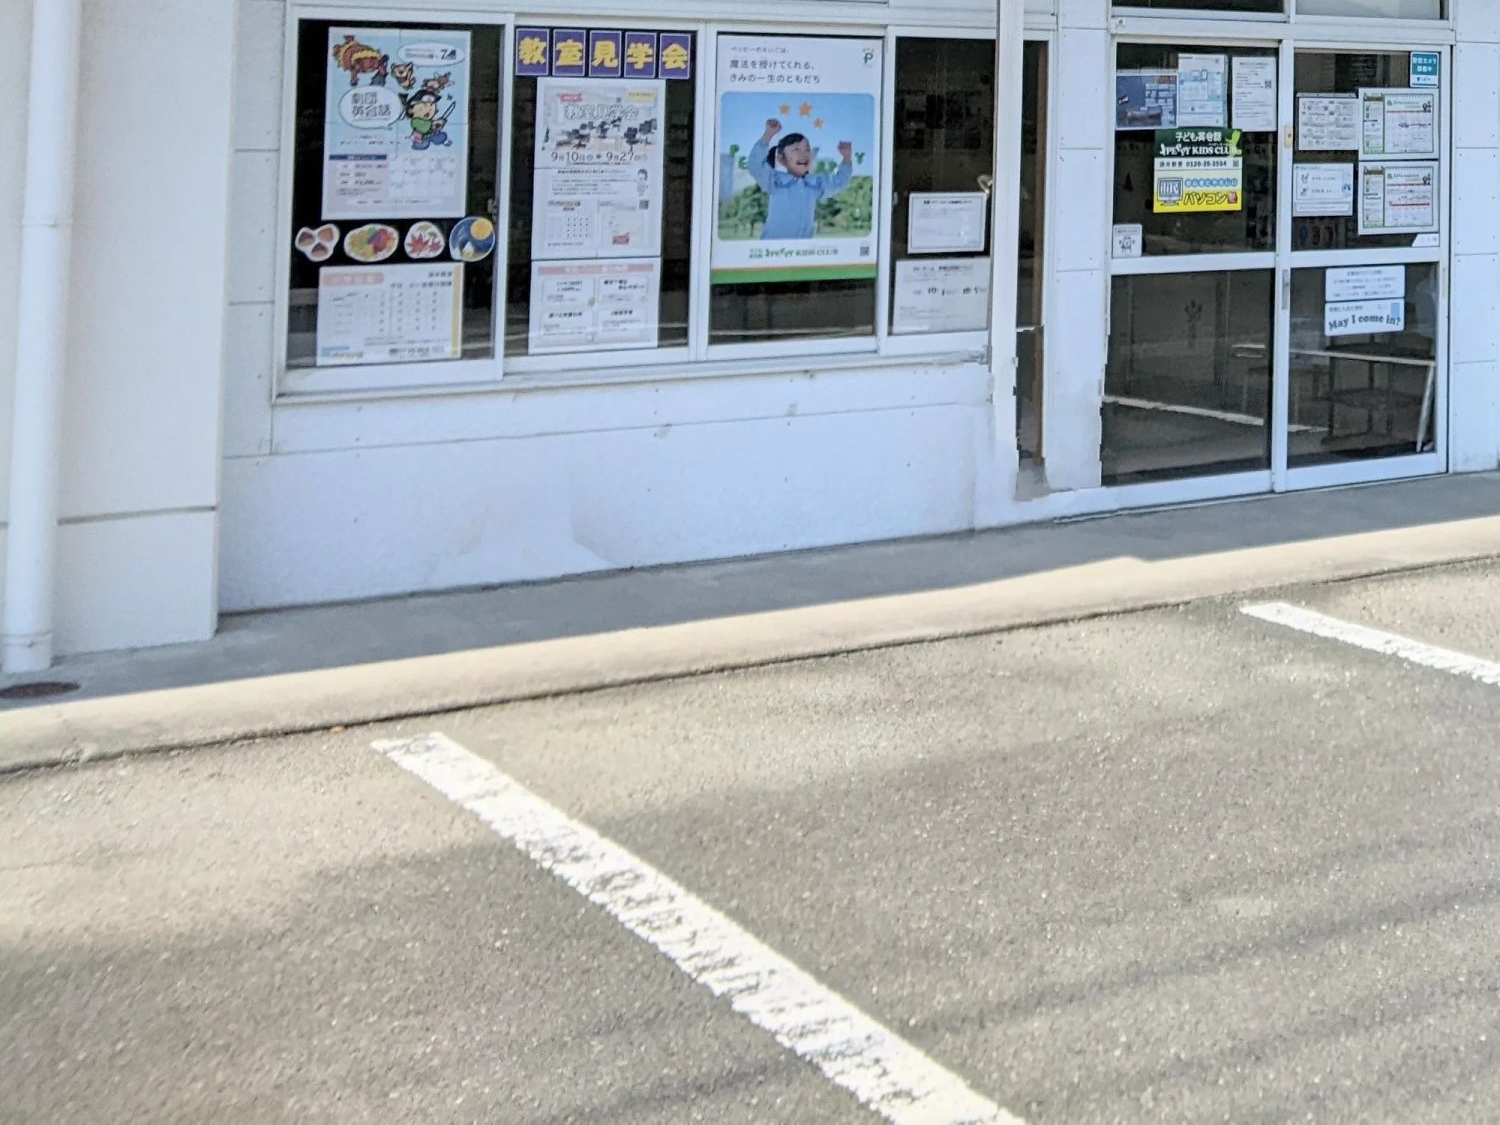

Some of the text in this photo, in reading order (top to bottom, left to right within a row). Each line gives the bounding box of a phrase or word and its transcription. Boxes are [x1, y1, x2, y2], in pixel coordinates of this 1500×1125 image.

[518, 36, 688, 70] 教室見学会
[1328, 318, 1349, 331] May
[1351, 315, 1356, 324] I
[1358, 315, 1384, 323] come
